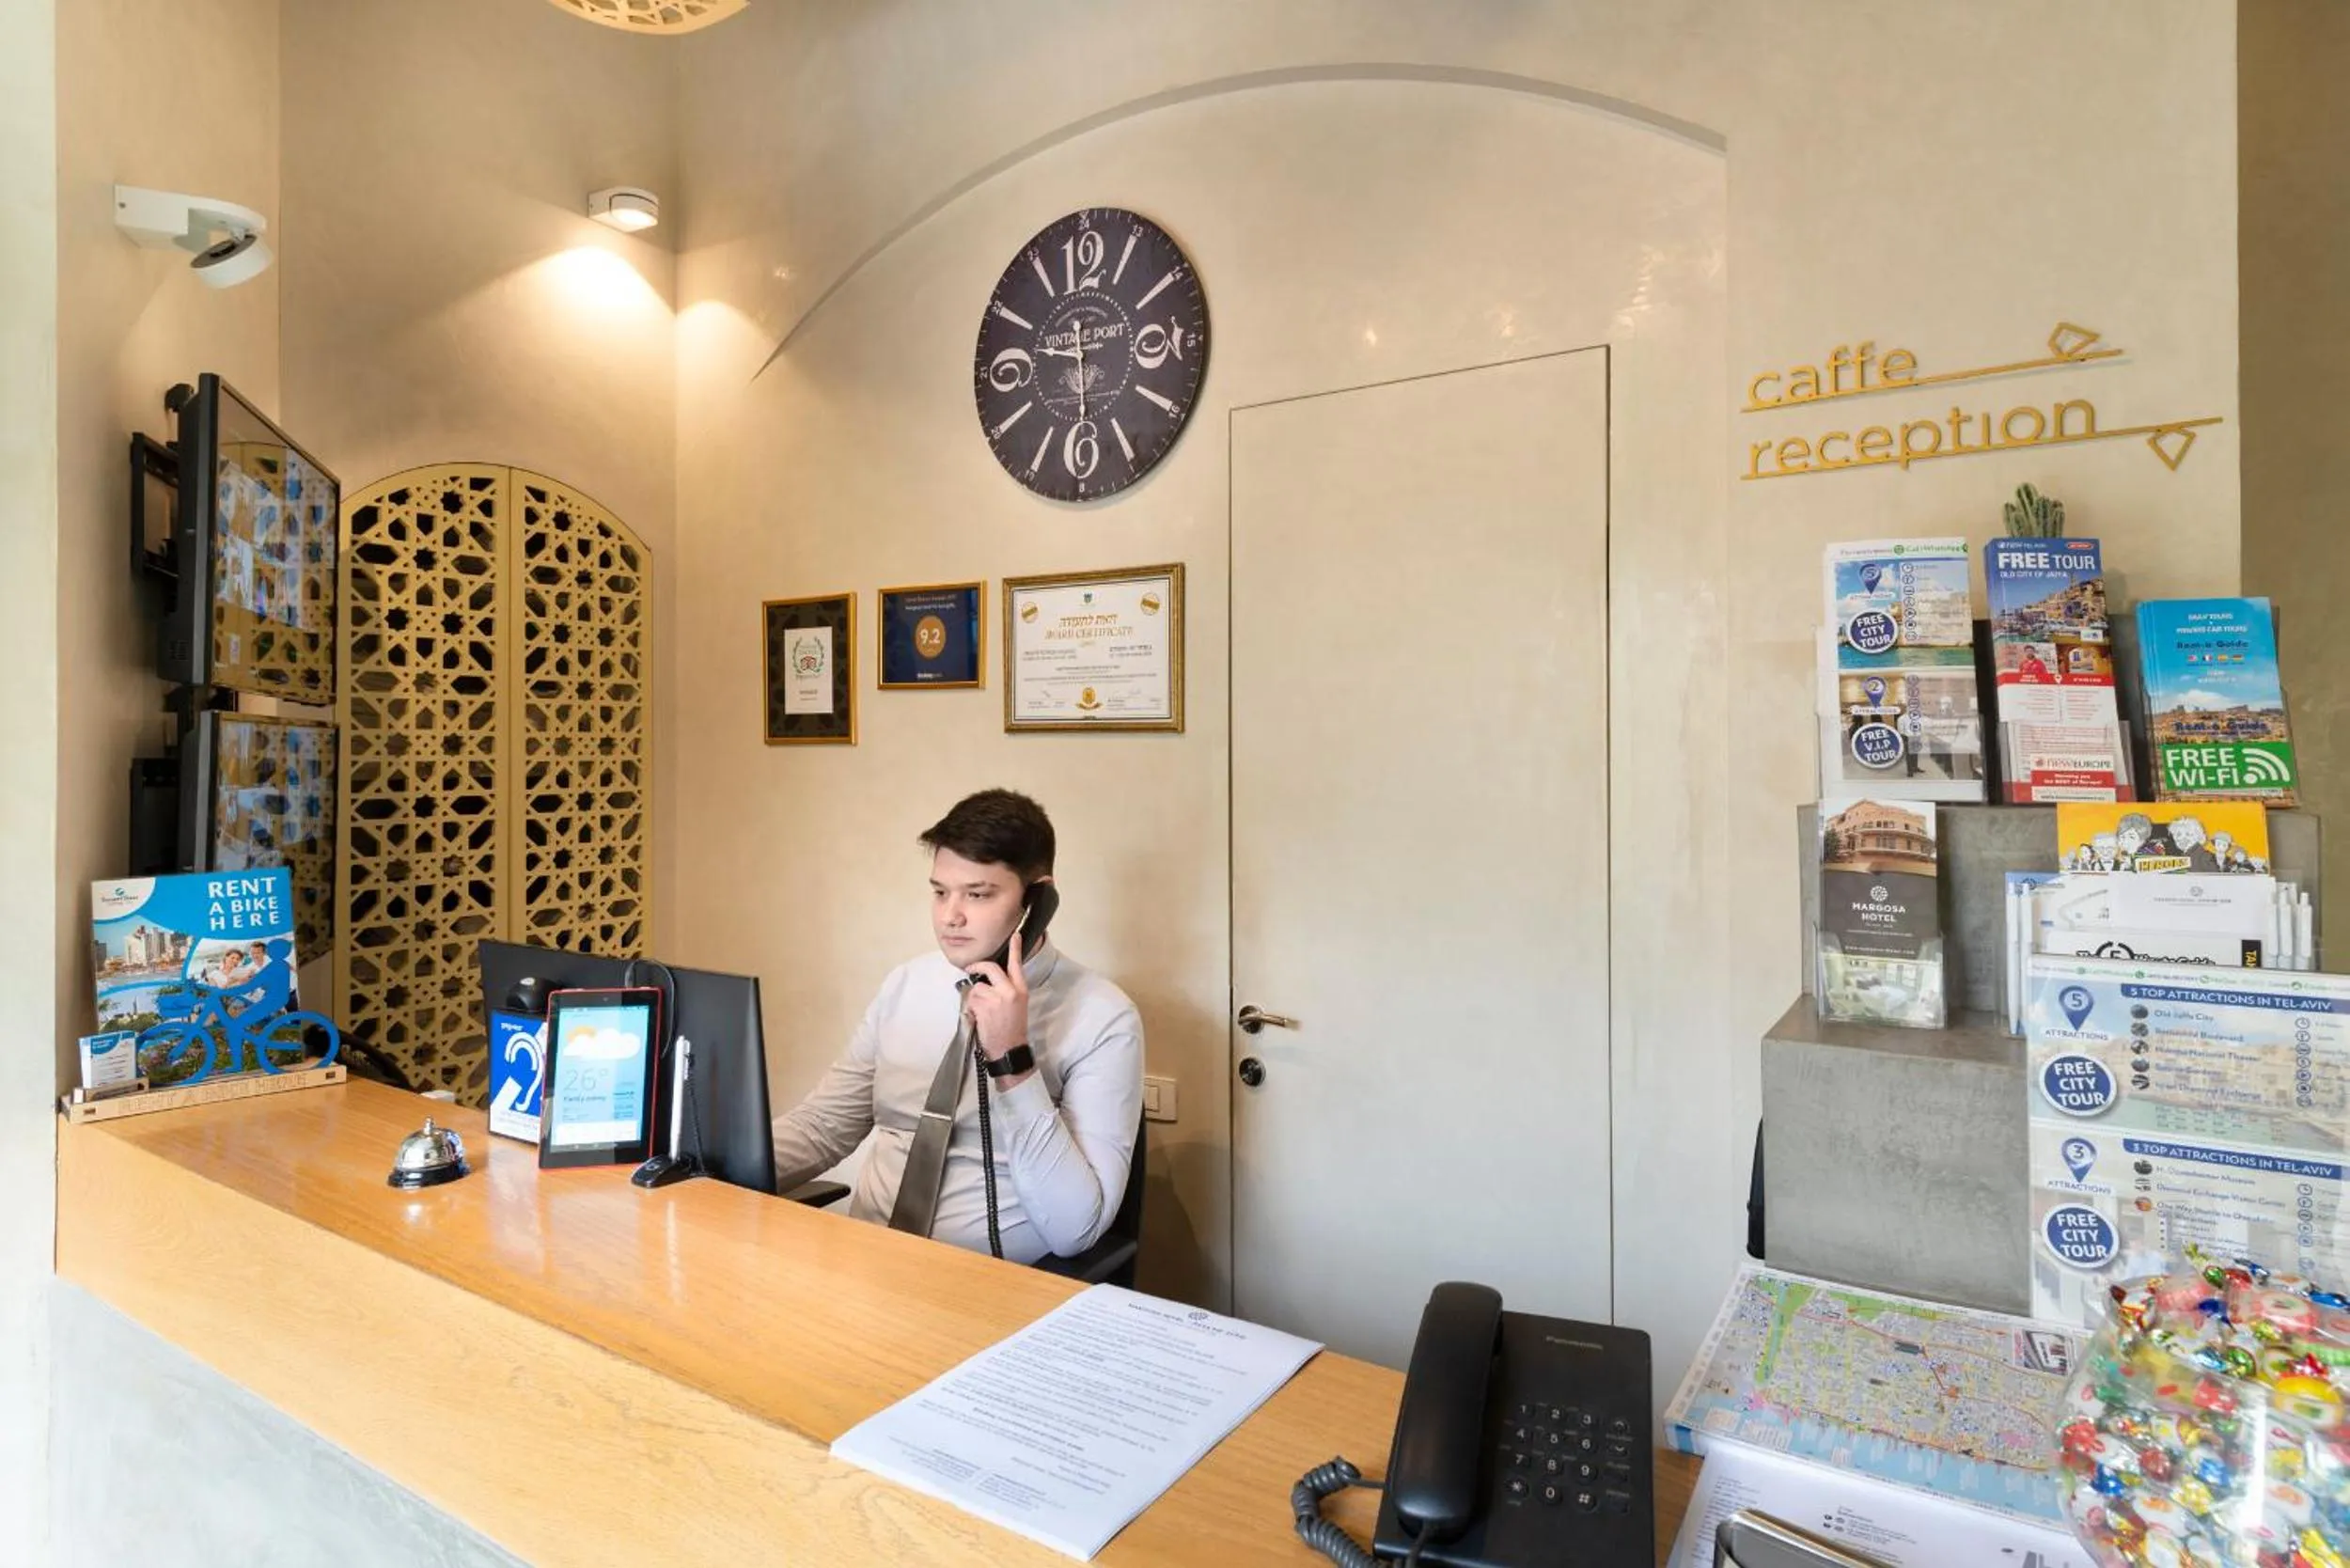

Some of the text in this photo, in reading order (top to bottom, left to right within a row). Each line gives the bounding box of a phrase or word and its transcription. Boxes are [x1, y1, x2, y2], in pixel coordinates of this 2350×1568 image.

[1060, 231, 1106, 296] 12
[1093, 323, 1126, 339] PORT
[1135, 316, 1184, 369] 3
[1186, 332, 1197, 348] 15
[990, 347, 1033, 393] 9
[1747, 340, 1919, 408] caffe
[1749, 399, 2096, 477] reception
[1063, 420, 1100, 479] 6
[1998, 553, 2095, 570] FREE TOUR
[1856, 612, 1885, 628] FREE
[919, 628, 941, 647] 9.2
[1860, 624, 1887, 638] CITY
[1859, 635, 1892, 649] TOUR
[1861, 729, 1889, 742] FREE
[1864, 749, 1896, 762] TOUR
[2166, 747, 2236, 768] FREE
[2170, 767, 2239, 788] WI-FI
[208, 876, 277, 899] RENT
[209, 896, 279, 916] A BIKE
[1853, 902, 1905, 914] MARGOSA
[210, 911, 280, 932] HERE
[1861, 913, 1897, 923] HOTEL
[2071, 994, 2083, 1008] 5
[2129, 987, 2332, 1011] 5 TOP ATTRACTIONS IN TEL-AVIV
[2045, 1029, 2108, 1042] ATTRACTIONS
[2054, 1061, 2095, 1075] FREE
[2060, 1077, 2096, 1091] CITY
[2058, 1092, 2106, 1107] TOUR
[2073, 1144, 2084, 1159] 3
[2142, 1143, 2169, 1156] TOP
[2170, 1145, 2257, 1168] ATTRACTIONS
[2259, 1159, 2274, 1169] IN
[2047, 1180, 2111, 1195] ATTRACTIONS
[2057, 1213, 2099, 1228] FREE
[2061, 1229, 2099, 1244] CITY
[2060, 1244, 2107, 1259] TOUR
[1582, 1439, 1590, 1450] 6
[1581, 1465, 1590, 1476] 9
[1545, 1486, 1556, 1498] 0
